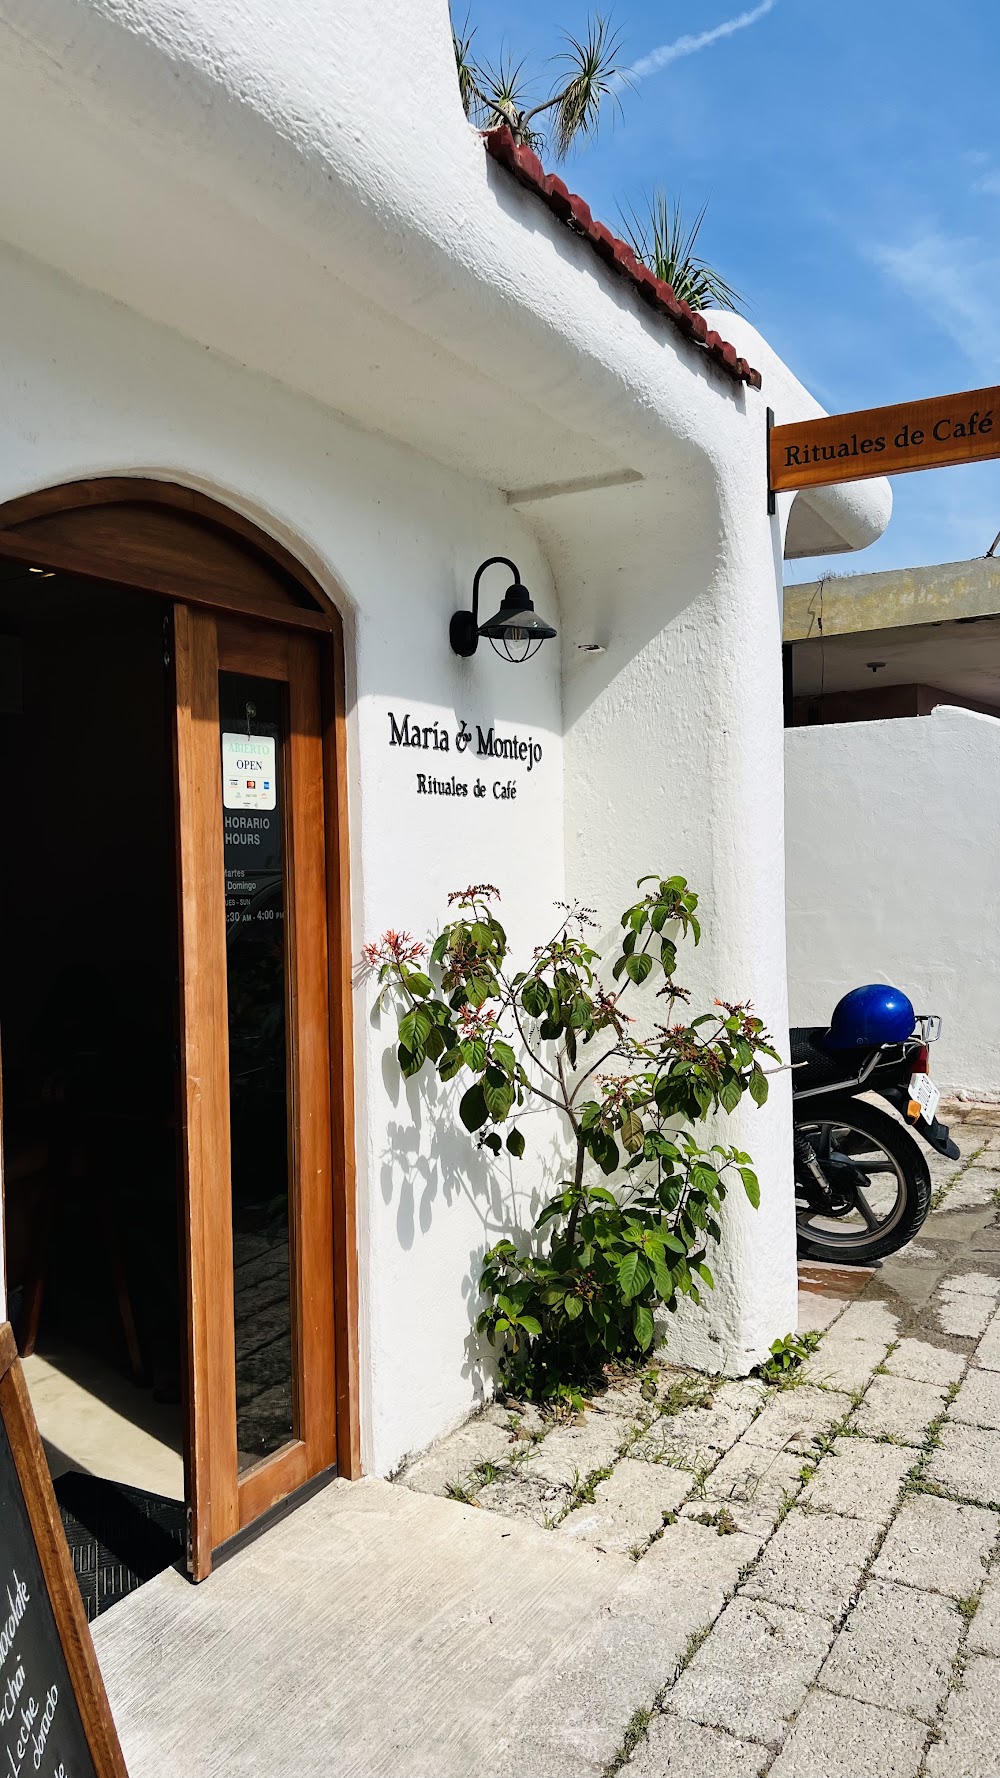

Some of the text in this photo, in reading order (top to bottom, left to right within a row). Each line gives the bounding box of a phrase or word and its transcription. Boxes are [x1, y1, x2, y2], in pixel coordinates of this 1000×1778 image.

[784, 411, 993, 467] Rituales de Café
[387, 712, 543, 772] María & Montejo
[228, 743, 270, 755] ABIERTO
[236, 759, 263, 770] OPEN
[416, 774, 517, 800] Rituales de Café
[225, 816, 270, 830] HORARIO
[225, 833, 261, 846] HOURS
[227, 881, 257, 892] Domingo
[240, 898, 251, 906] SUN
[226, 911, 241, 923] :30
[242, 914, 252, 922] AM
[257, 910, 274, 921] 4:00
[33, 1685, 59, 1770] dorado
[6, 1697, 40, 1778] Leche
